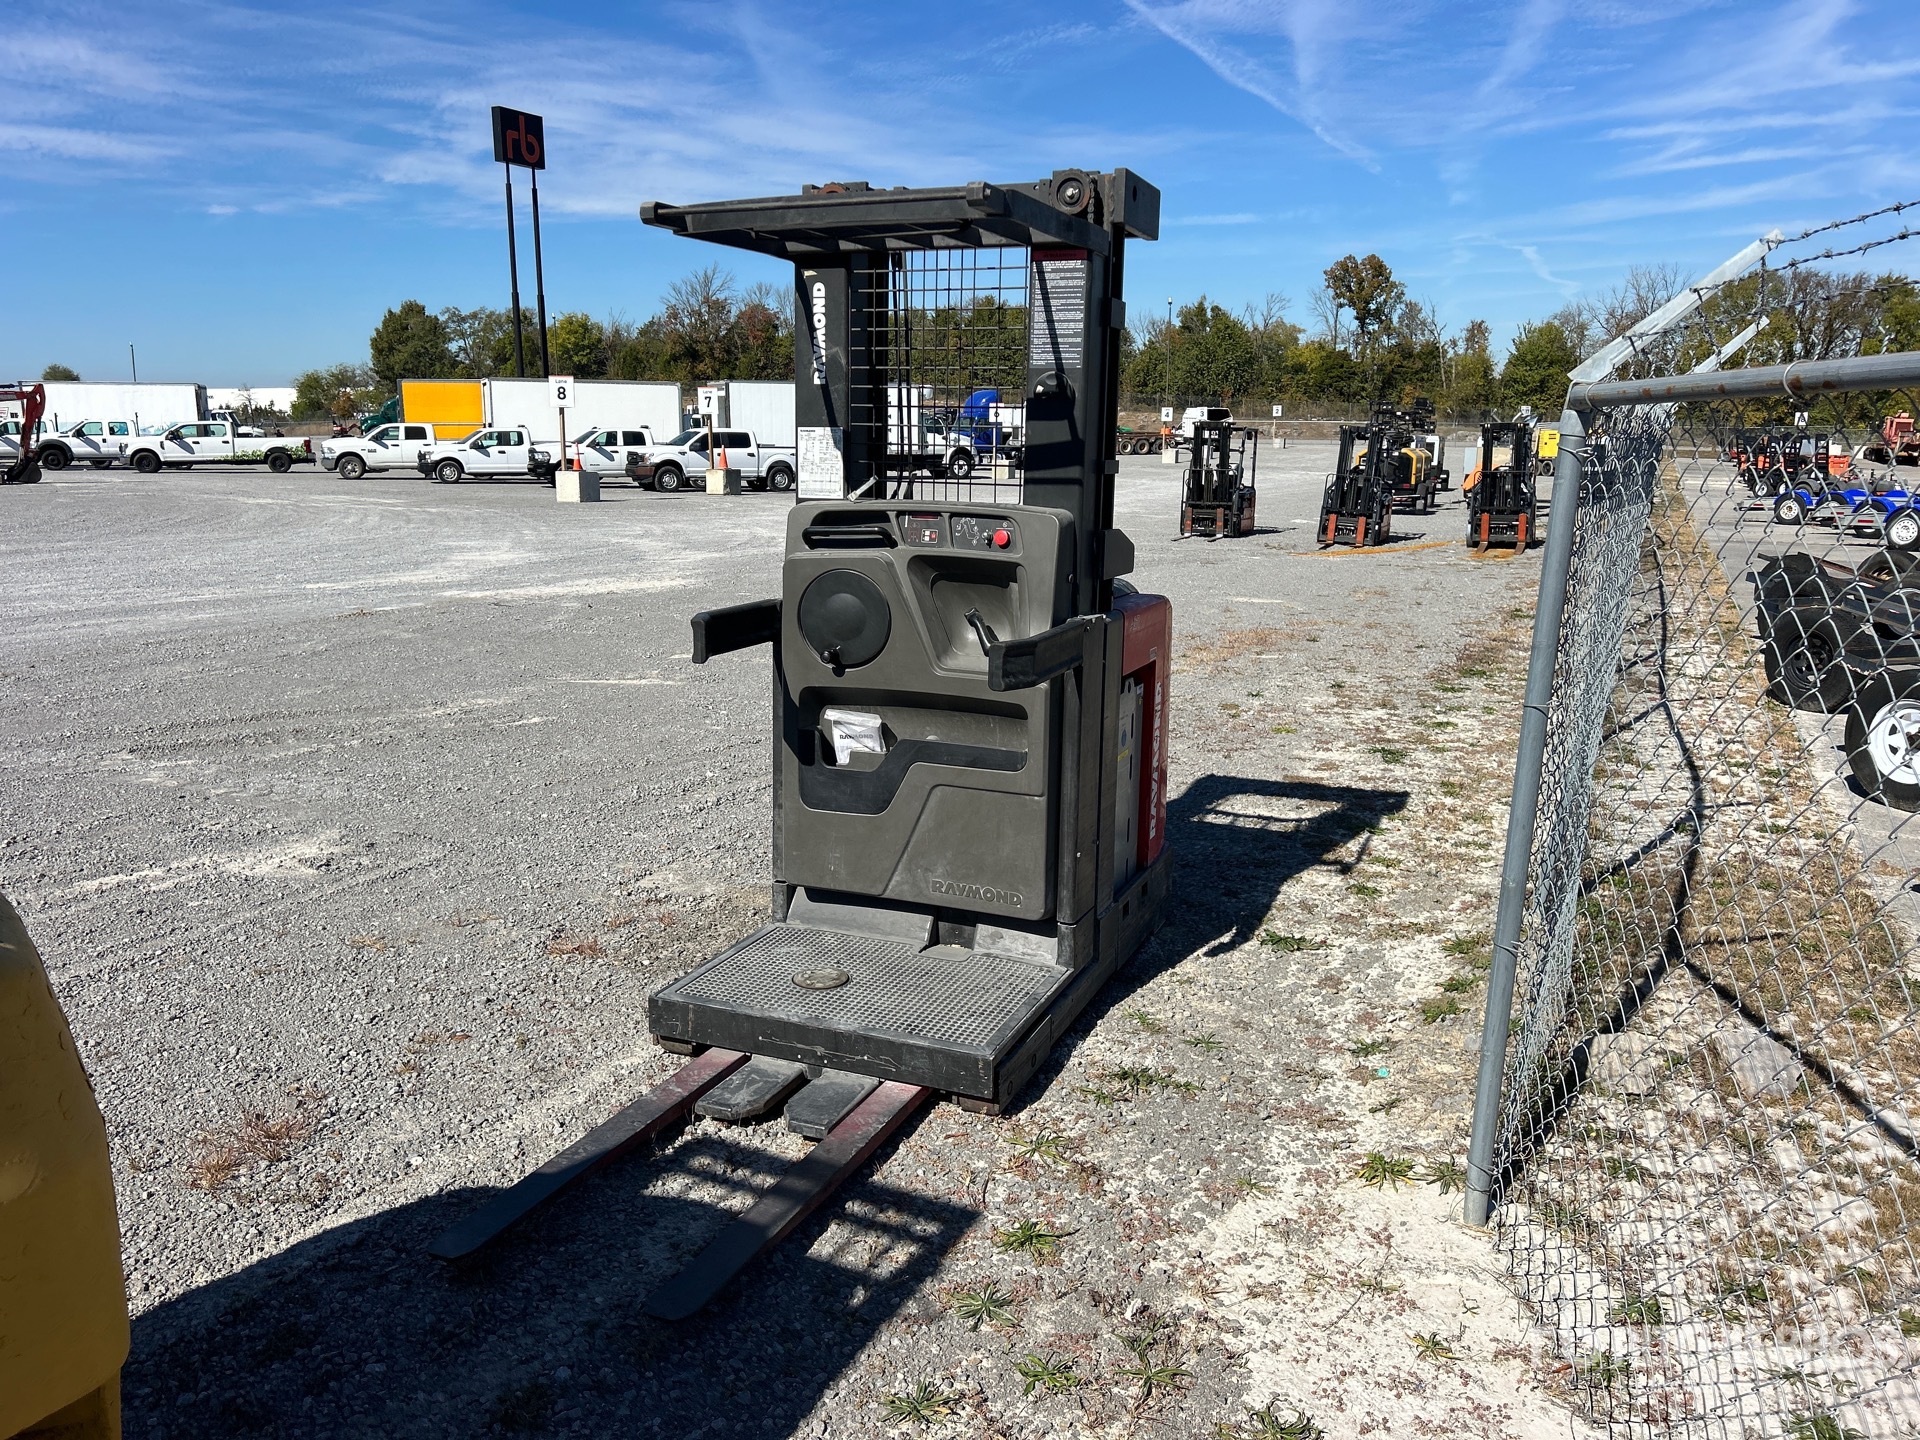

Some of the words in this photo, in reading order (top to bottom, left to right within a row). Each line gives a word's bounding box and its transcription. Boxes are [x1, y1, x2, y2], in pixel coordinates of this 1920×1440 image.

[507, 115, 540, 163] rb
[813, 281, 827, 386] RAYMOND
[557, 386, 566, 400] 8
[704, 396, 712, 408] 7
[931, 878, 1023, 907] RAYMOND
